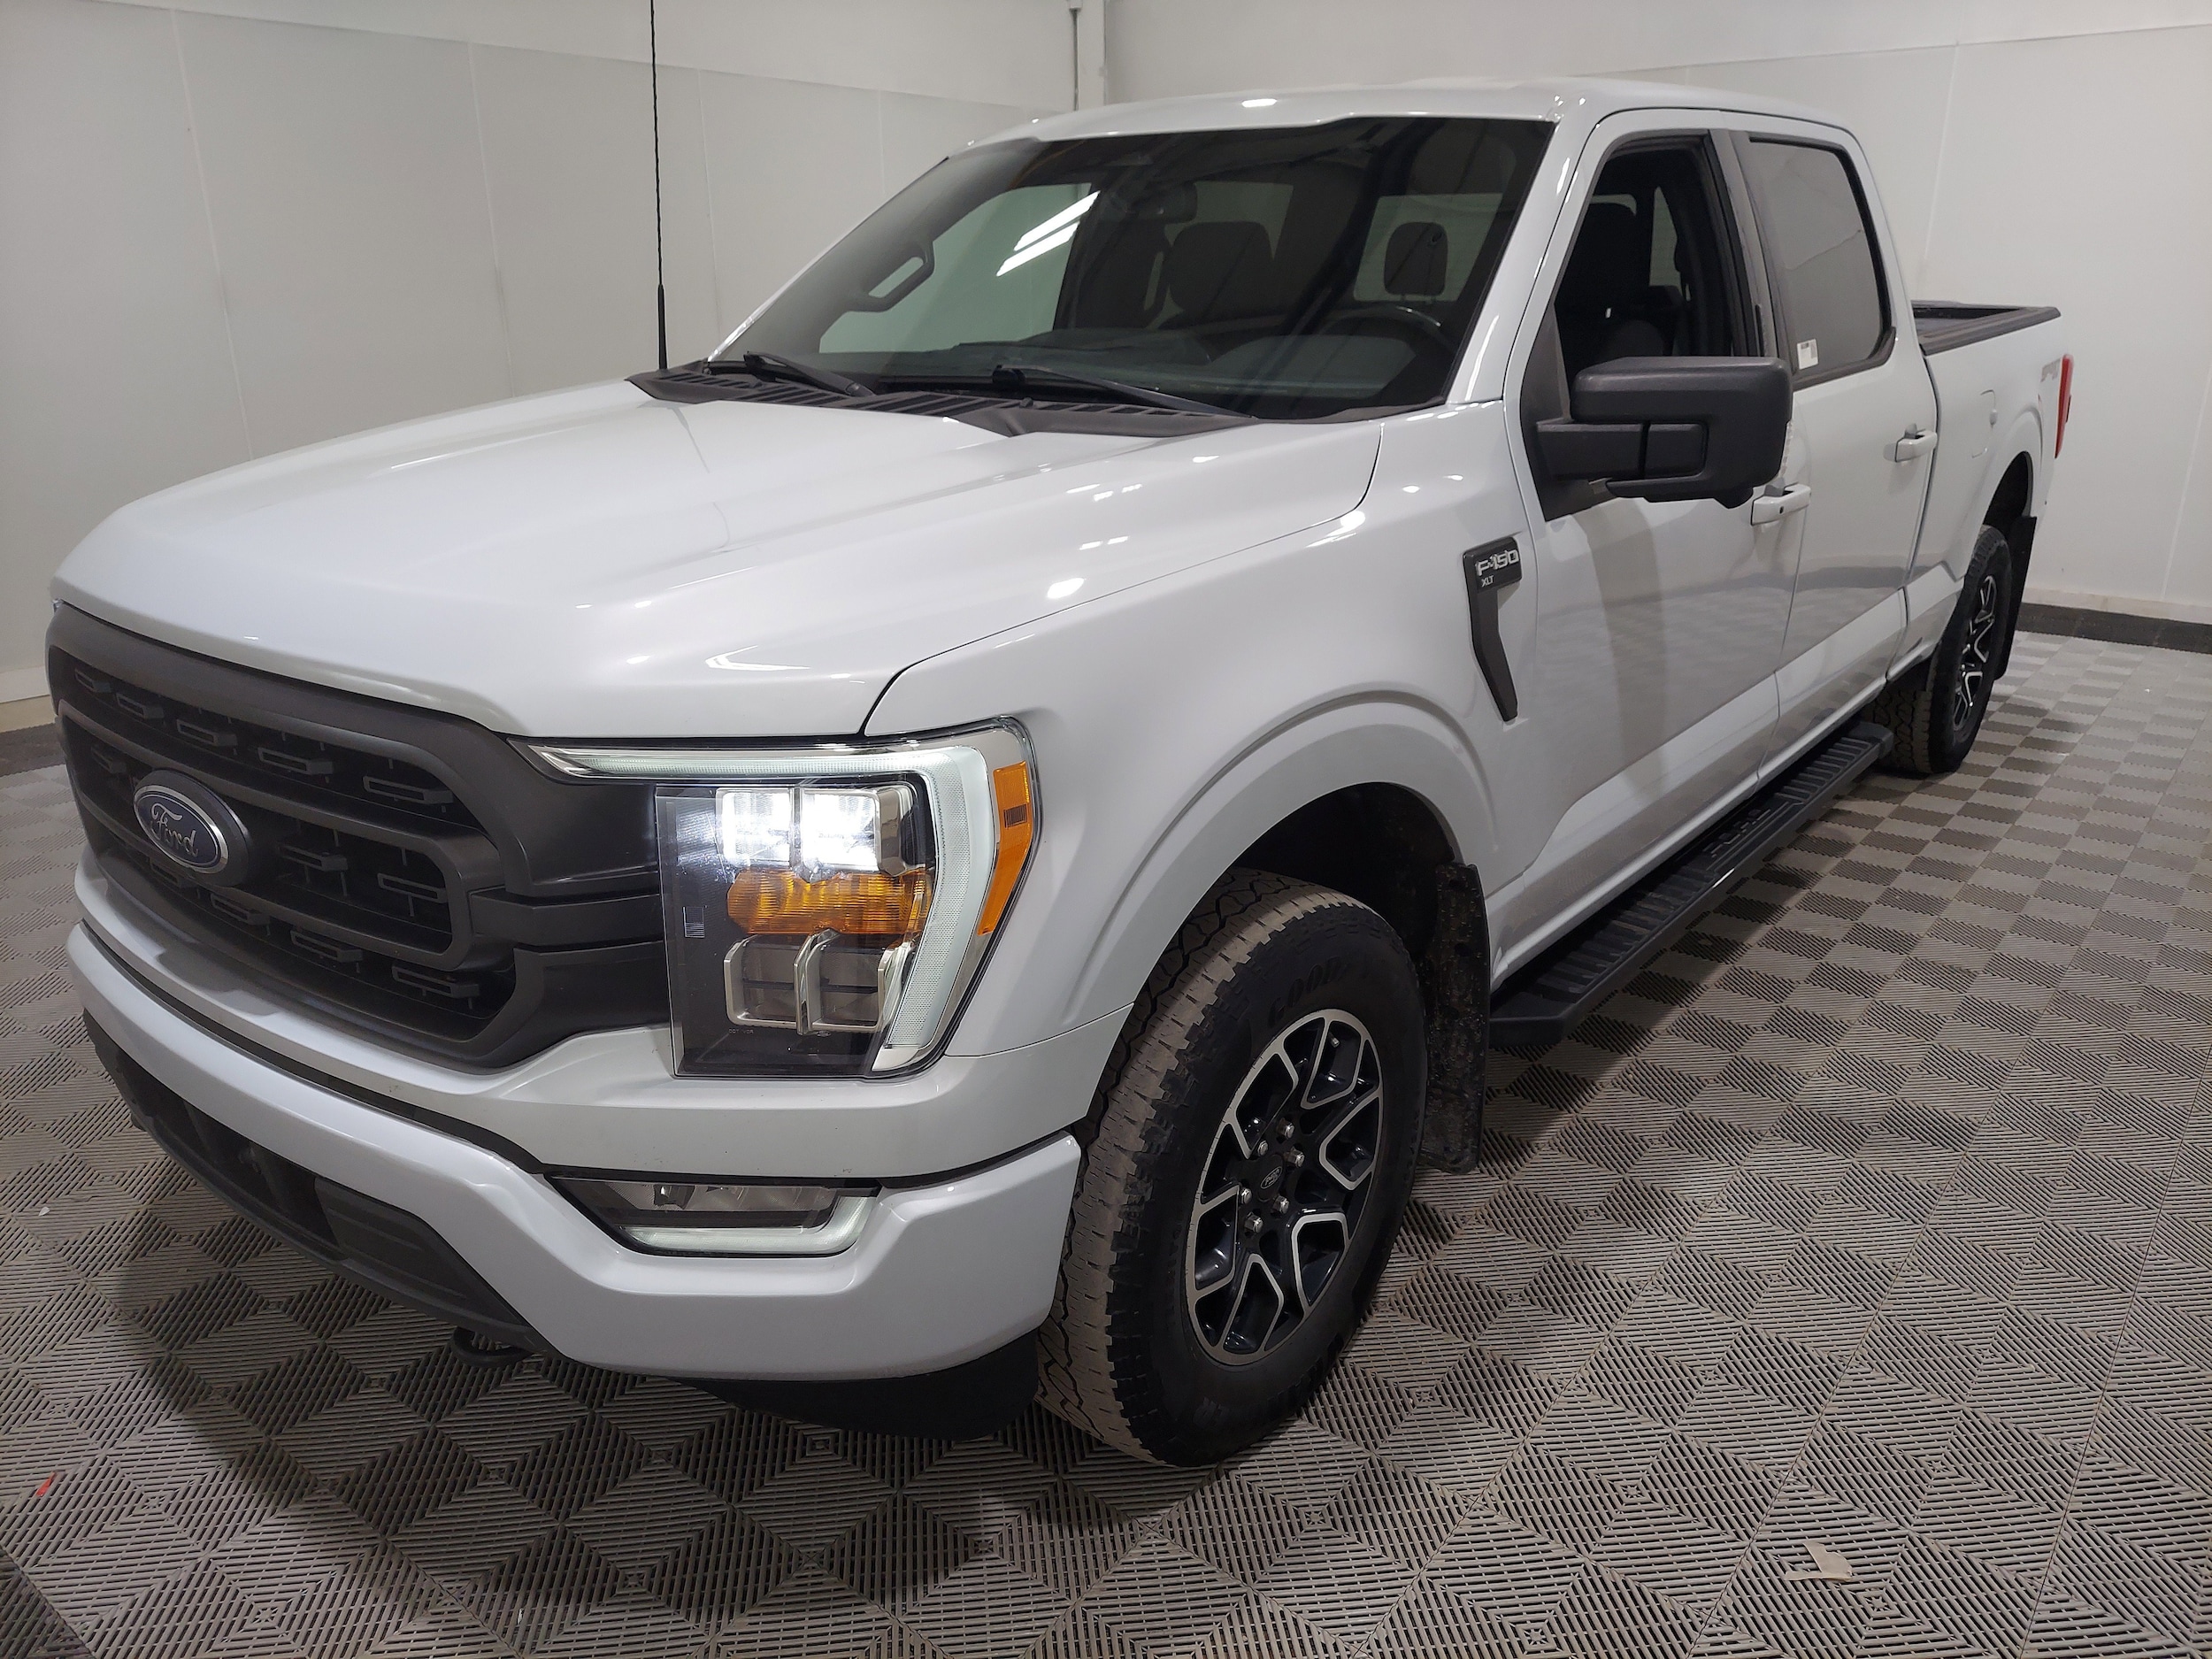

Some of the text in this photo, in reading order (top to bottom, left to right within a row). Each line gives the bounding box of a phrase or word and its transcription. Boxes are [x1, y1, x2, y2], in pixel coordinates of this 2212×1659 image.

[1475, 549, 1519, 576] F-150
[1481, 575, 1494, 588] XLT
[151, 803, 198, 857] Ford
